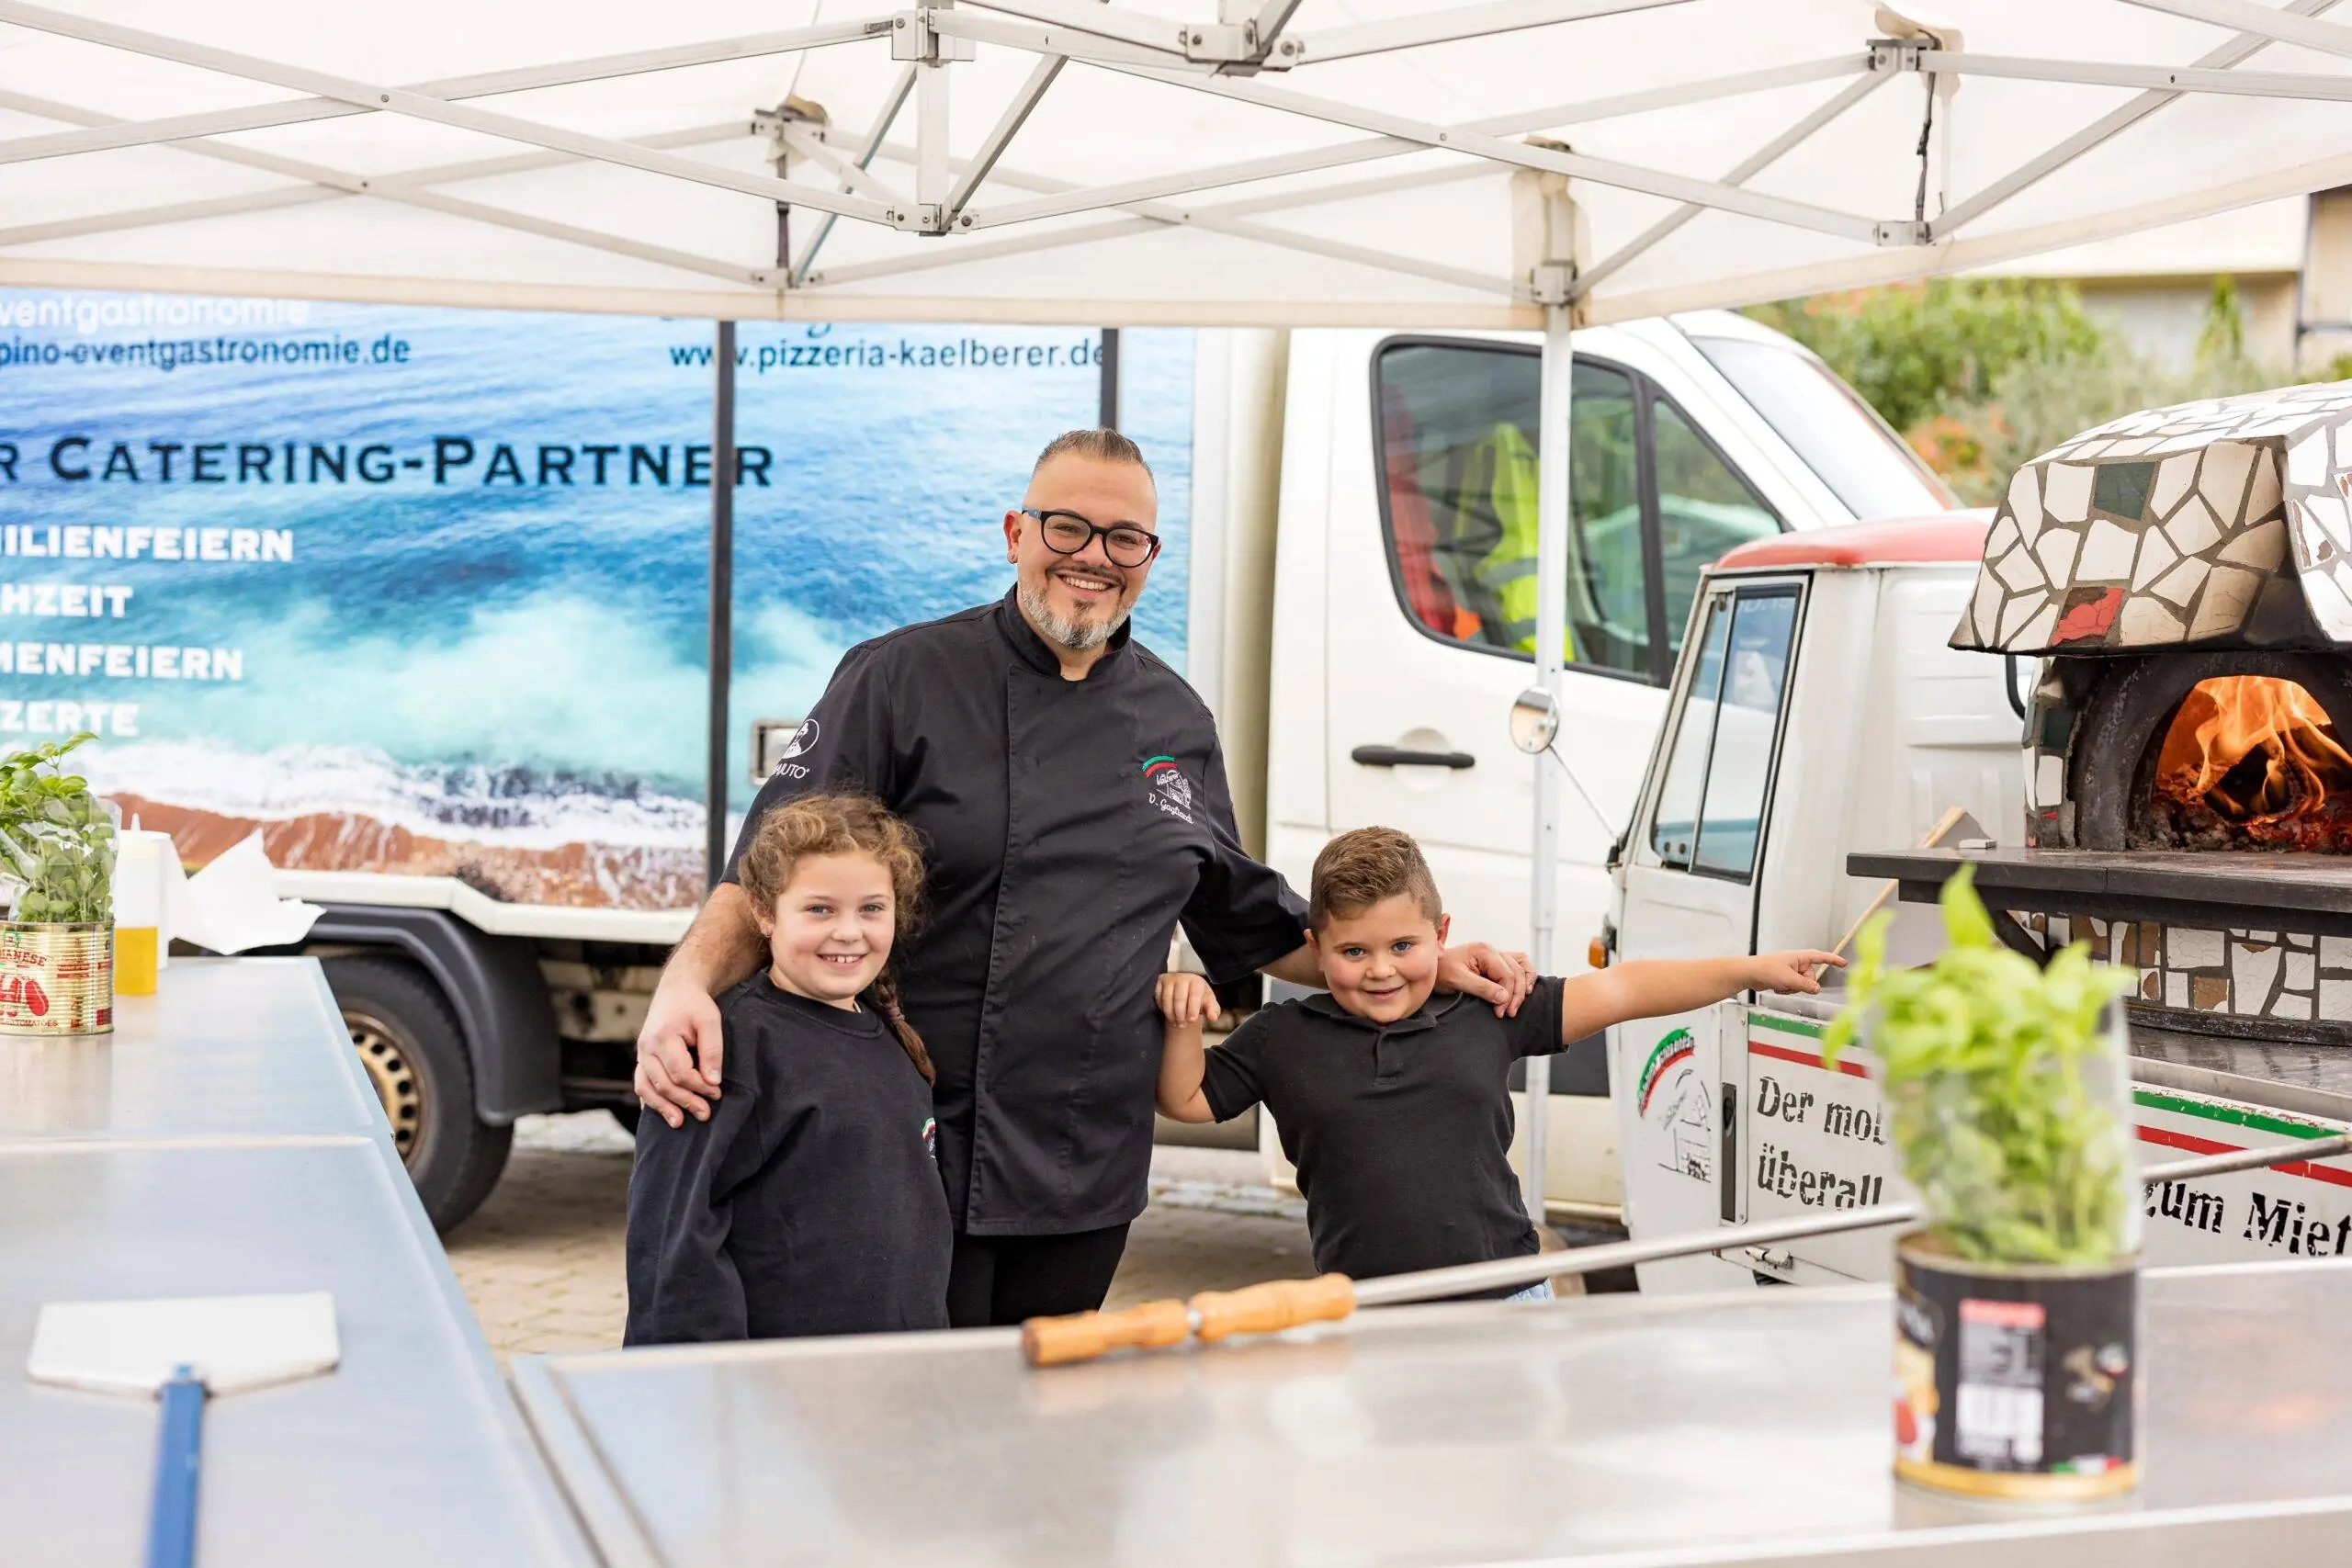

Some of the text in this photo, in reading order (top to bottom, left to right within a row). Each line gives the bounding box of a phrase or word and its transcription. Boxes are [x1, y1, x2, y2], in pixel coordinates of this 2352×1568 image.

[0, 525, 293, 562] ILIENFEIERN
[1757, 1076, 1814, 1123] Der
[1757, 1143, 1883, 1209] überall
